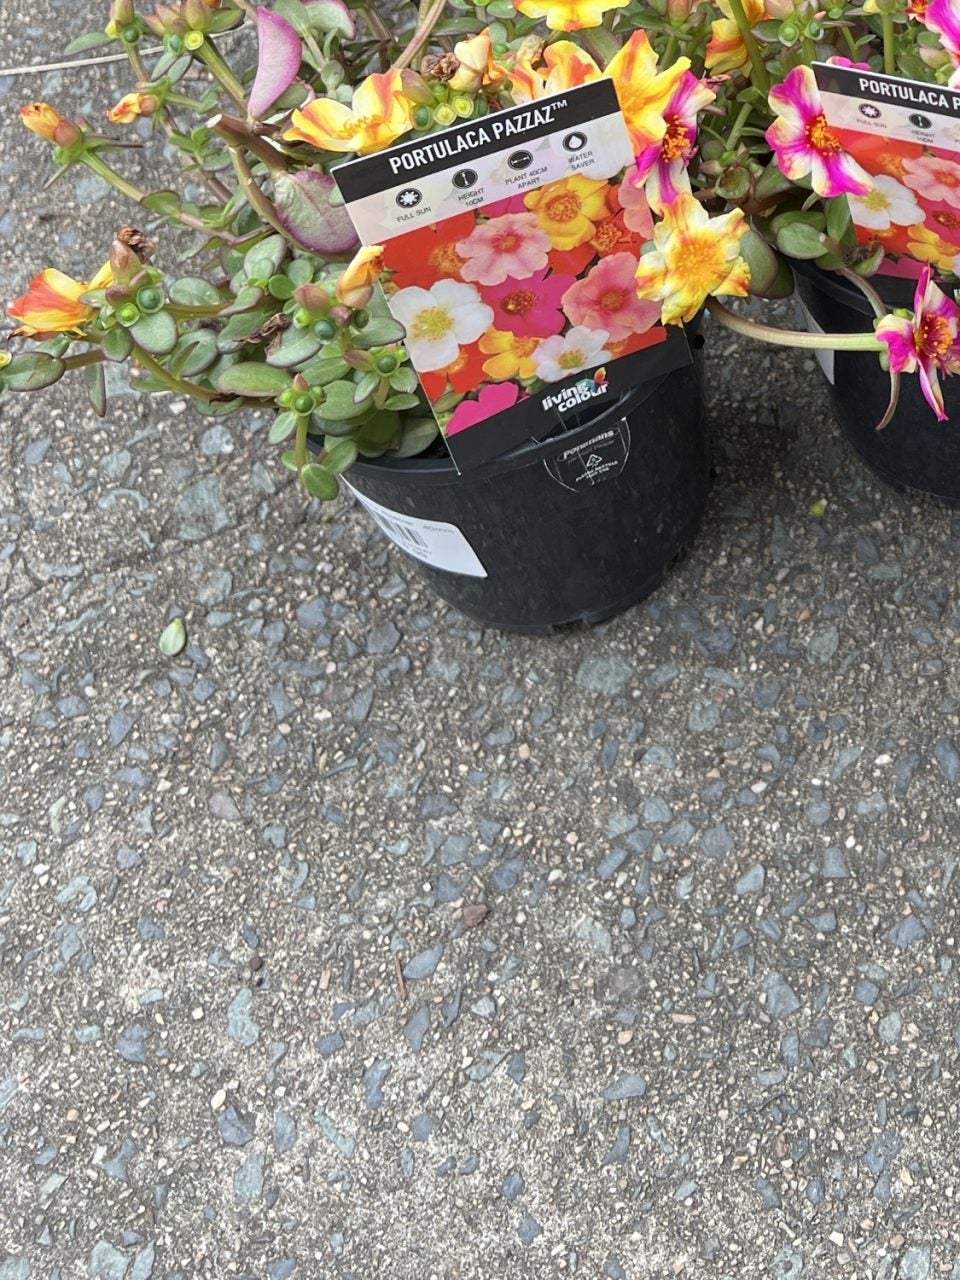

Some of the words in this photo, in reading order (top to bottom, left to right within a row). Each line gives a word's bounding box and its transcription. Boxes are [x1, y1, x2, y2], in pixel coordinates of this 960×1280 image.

[859, 78, 949, 108] PORTULACA
[389, 126, 491, 174] PORTULACA
[568, 151, 594, 164] WATER
[571, 158, 595, 171] SAVER
[504, 172, 528, 185] PLANT
[517, 177, 541, 189] APART
[458, 188, 485, 202] HEIGHT
[465, 197, 484, 208] 10CM
[397, 211, 414, 222] FULL
[415, 206, 432, 218] SUN
[541, 381, 589, 410] living
[557, 382, 607, 412] colour
